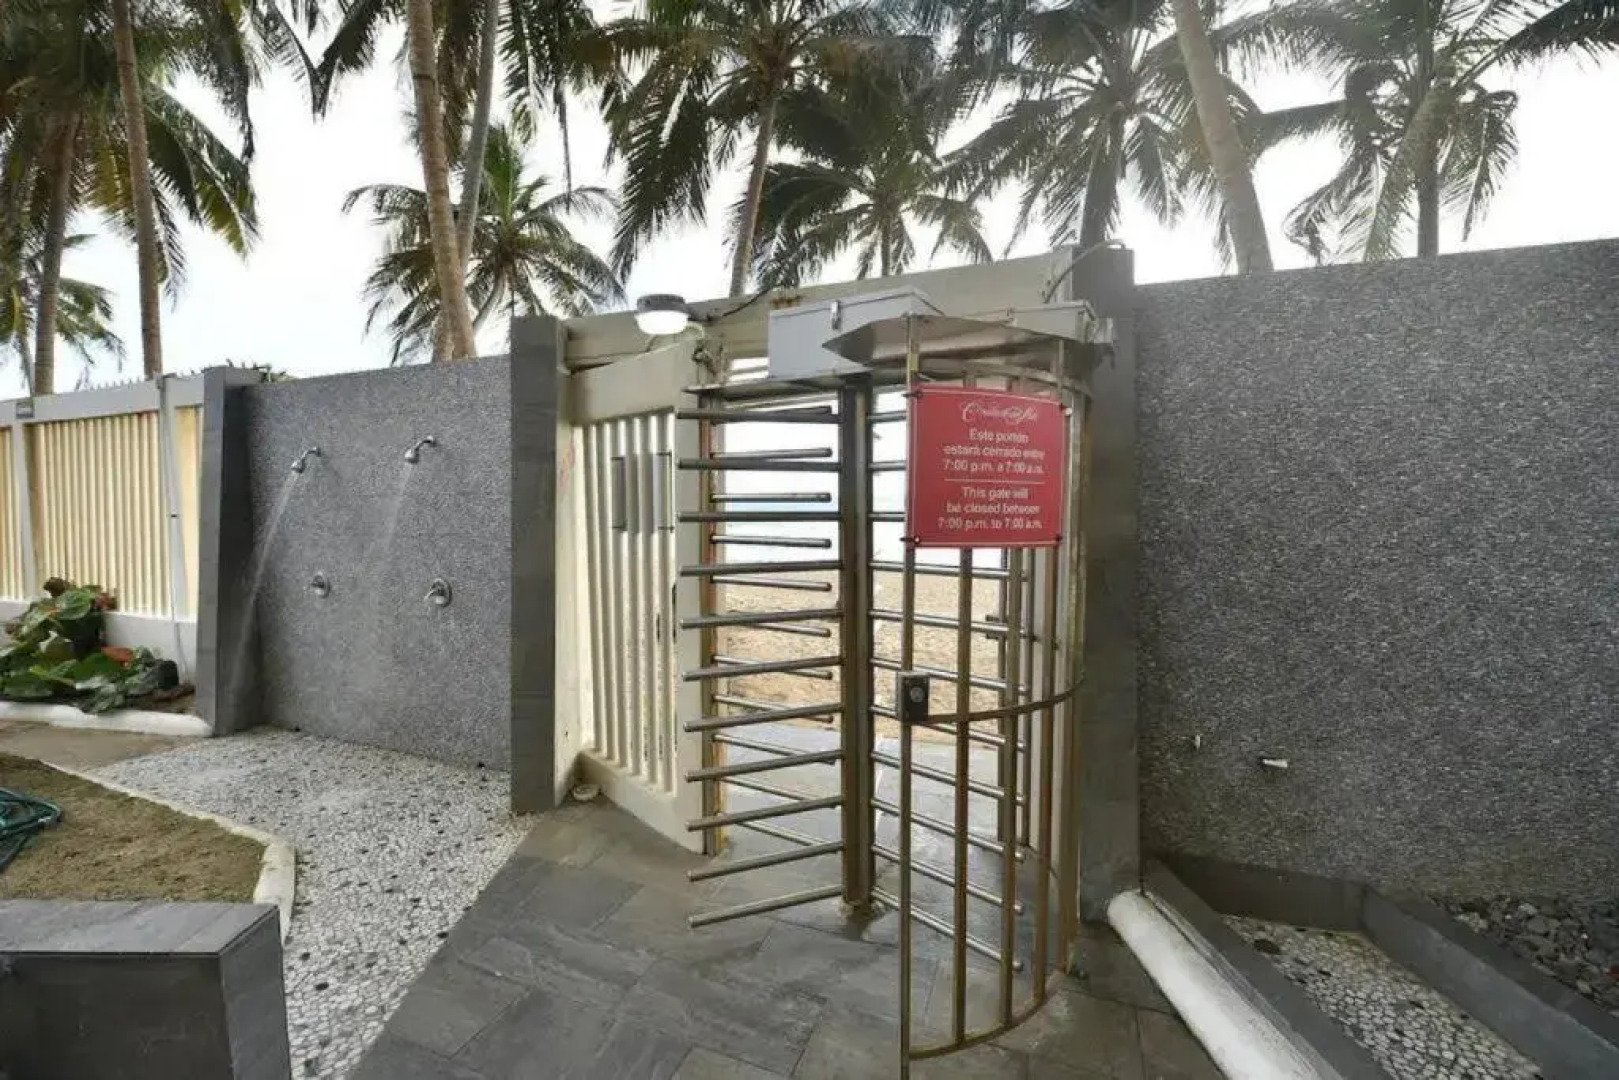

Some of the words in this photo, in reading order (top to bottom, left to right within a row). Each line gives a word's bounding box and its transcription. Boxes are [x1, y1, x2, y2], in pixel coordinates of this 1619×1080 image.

[969, 427, 994, 440] Este
[944, 459, 968, 472] 7:00
[962, 487, 986, 498] This
[988, 489, 1010, 501] gate
[1012, 488, 1029, 499] will
[946, 501, 961, 513] be
[964, 502, 1000, 514] closed
[938, 517, 963, 529] 7:00
[991, 518, 1002, 530] to
[1005, 518, 1024, 529] 7:00
